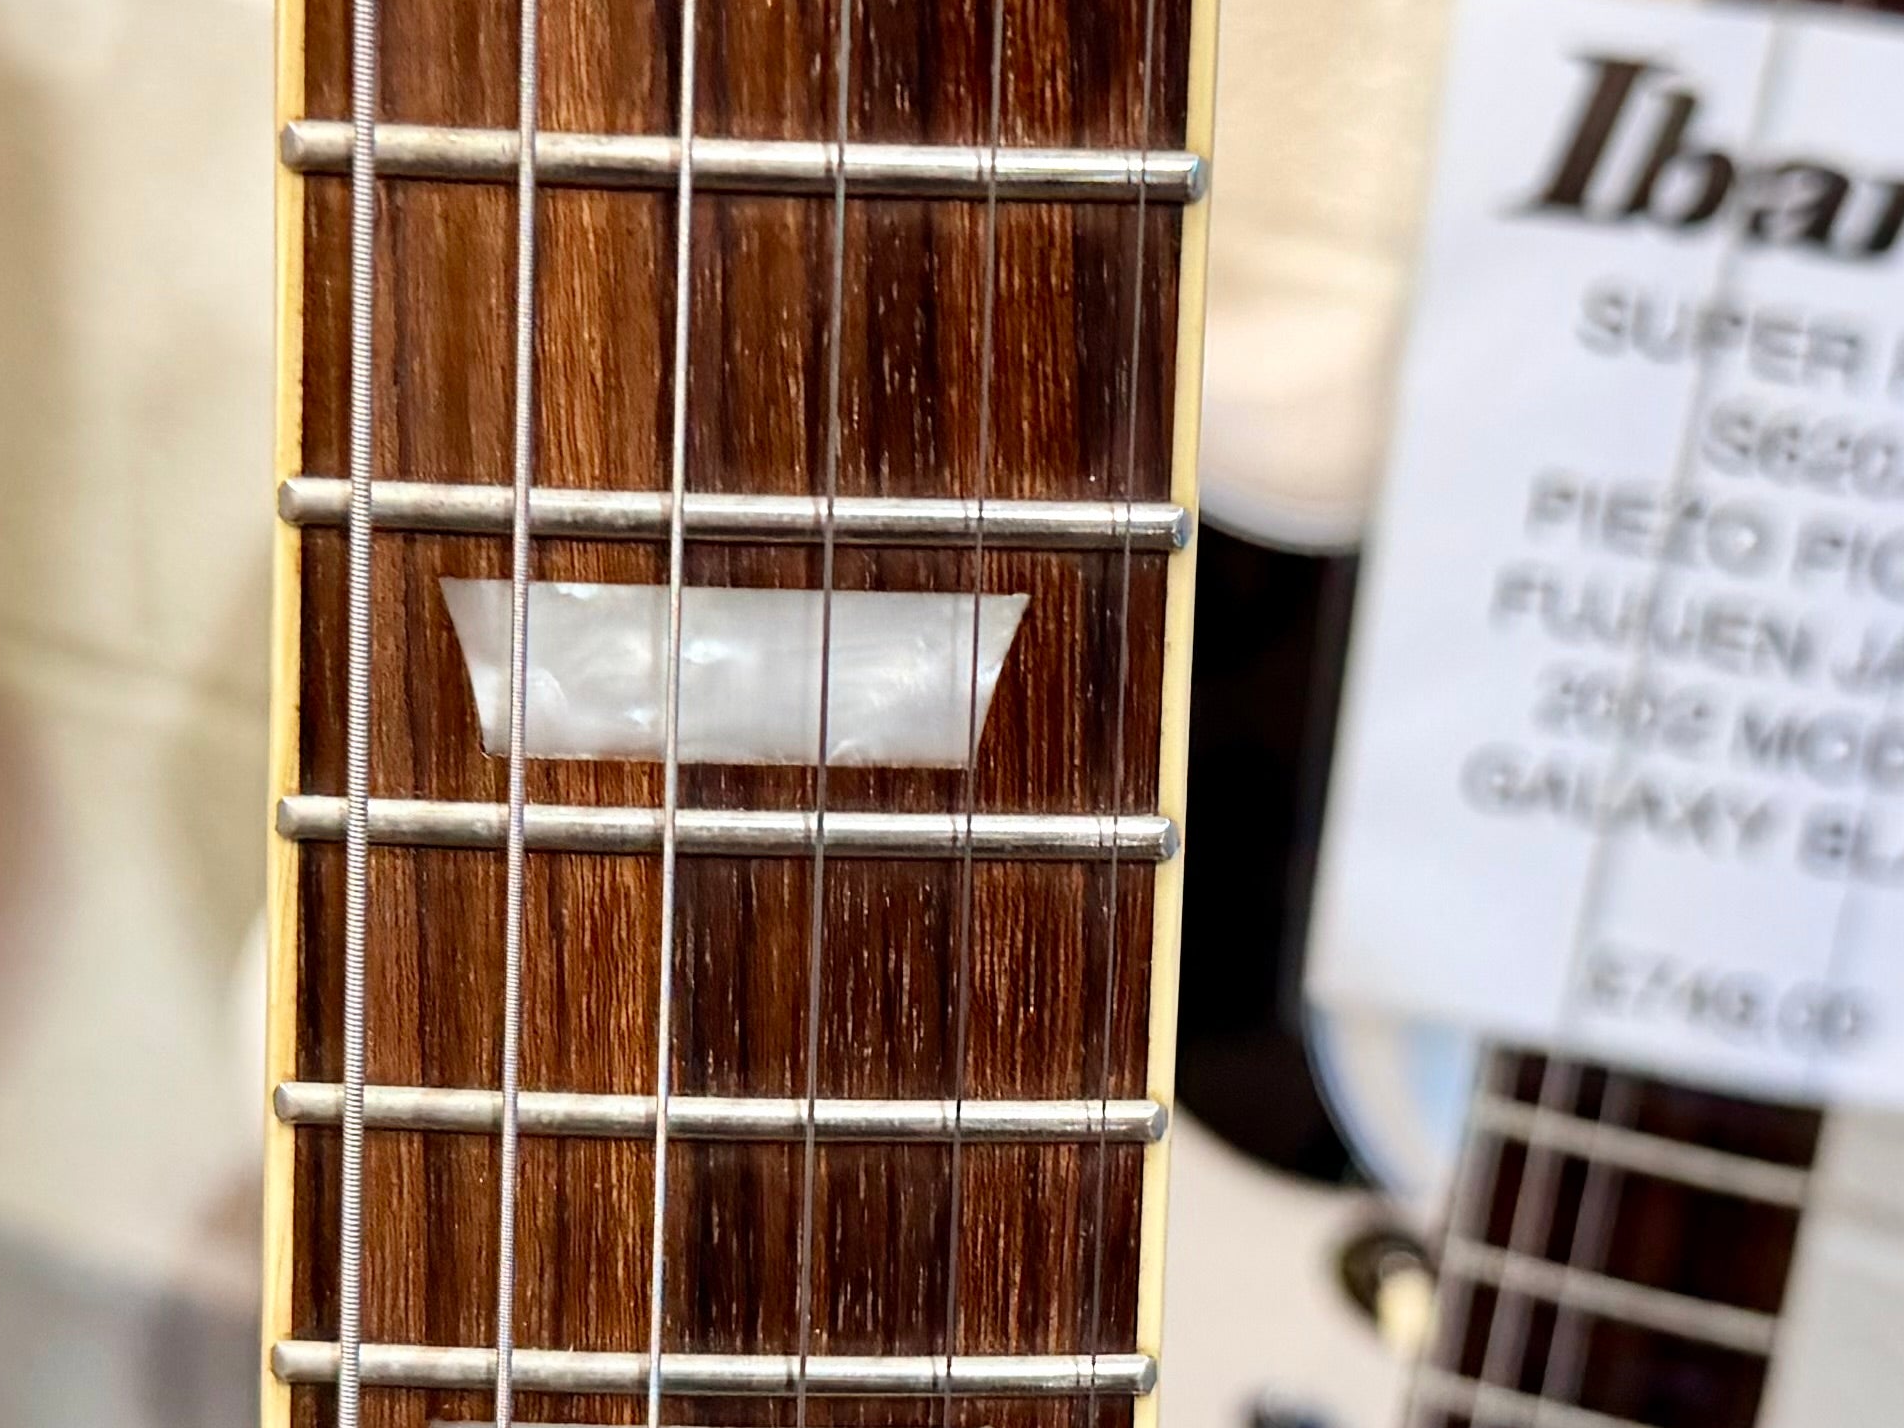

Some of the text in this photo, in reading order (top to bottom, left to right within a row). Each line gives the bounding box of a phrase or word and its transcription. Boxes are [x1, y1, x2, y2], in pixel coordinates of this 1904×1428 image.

[1574, 278, 1870, 393] SUPER
[1524, 467, 1784, 576] PIEZO
[1531, 662, 1719, 761] 2002
[1457, 742, 1780, 861] GALAXY
